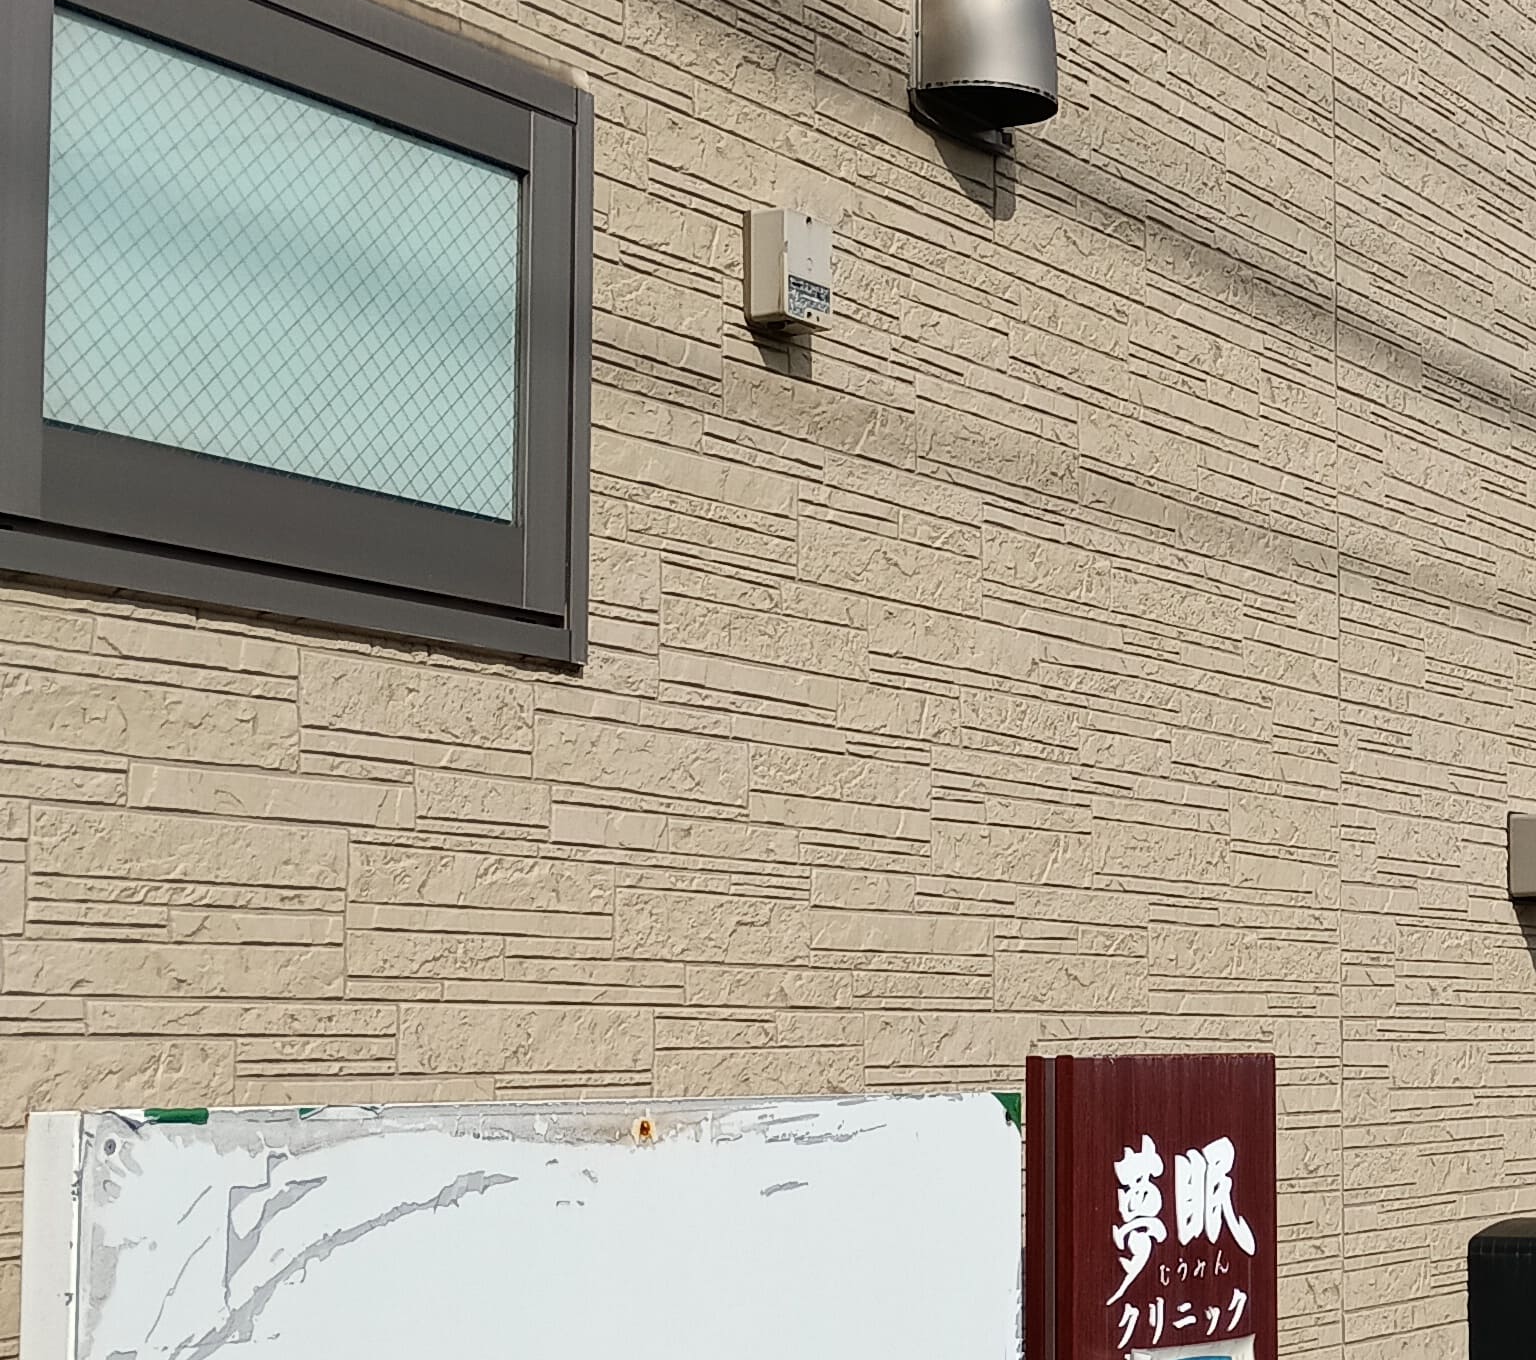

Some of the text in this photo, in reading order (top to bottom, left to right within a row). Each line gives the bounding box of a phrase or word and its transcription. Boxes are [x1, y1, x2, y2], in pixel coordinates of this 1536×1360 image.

[1105, 1133, 1257, 1307] 夢眠
[1159, 1249, 1230, 1287] むうみん
[1117, 1287, 1248, 1350] クリニック
